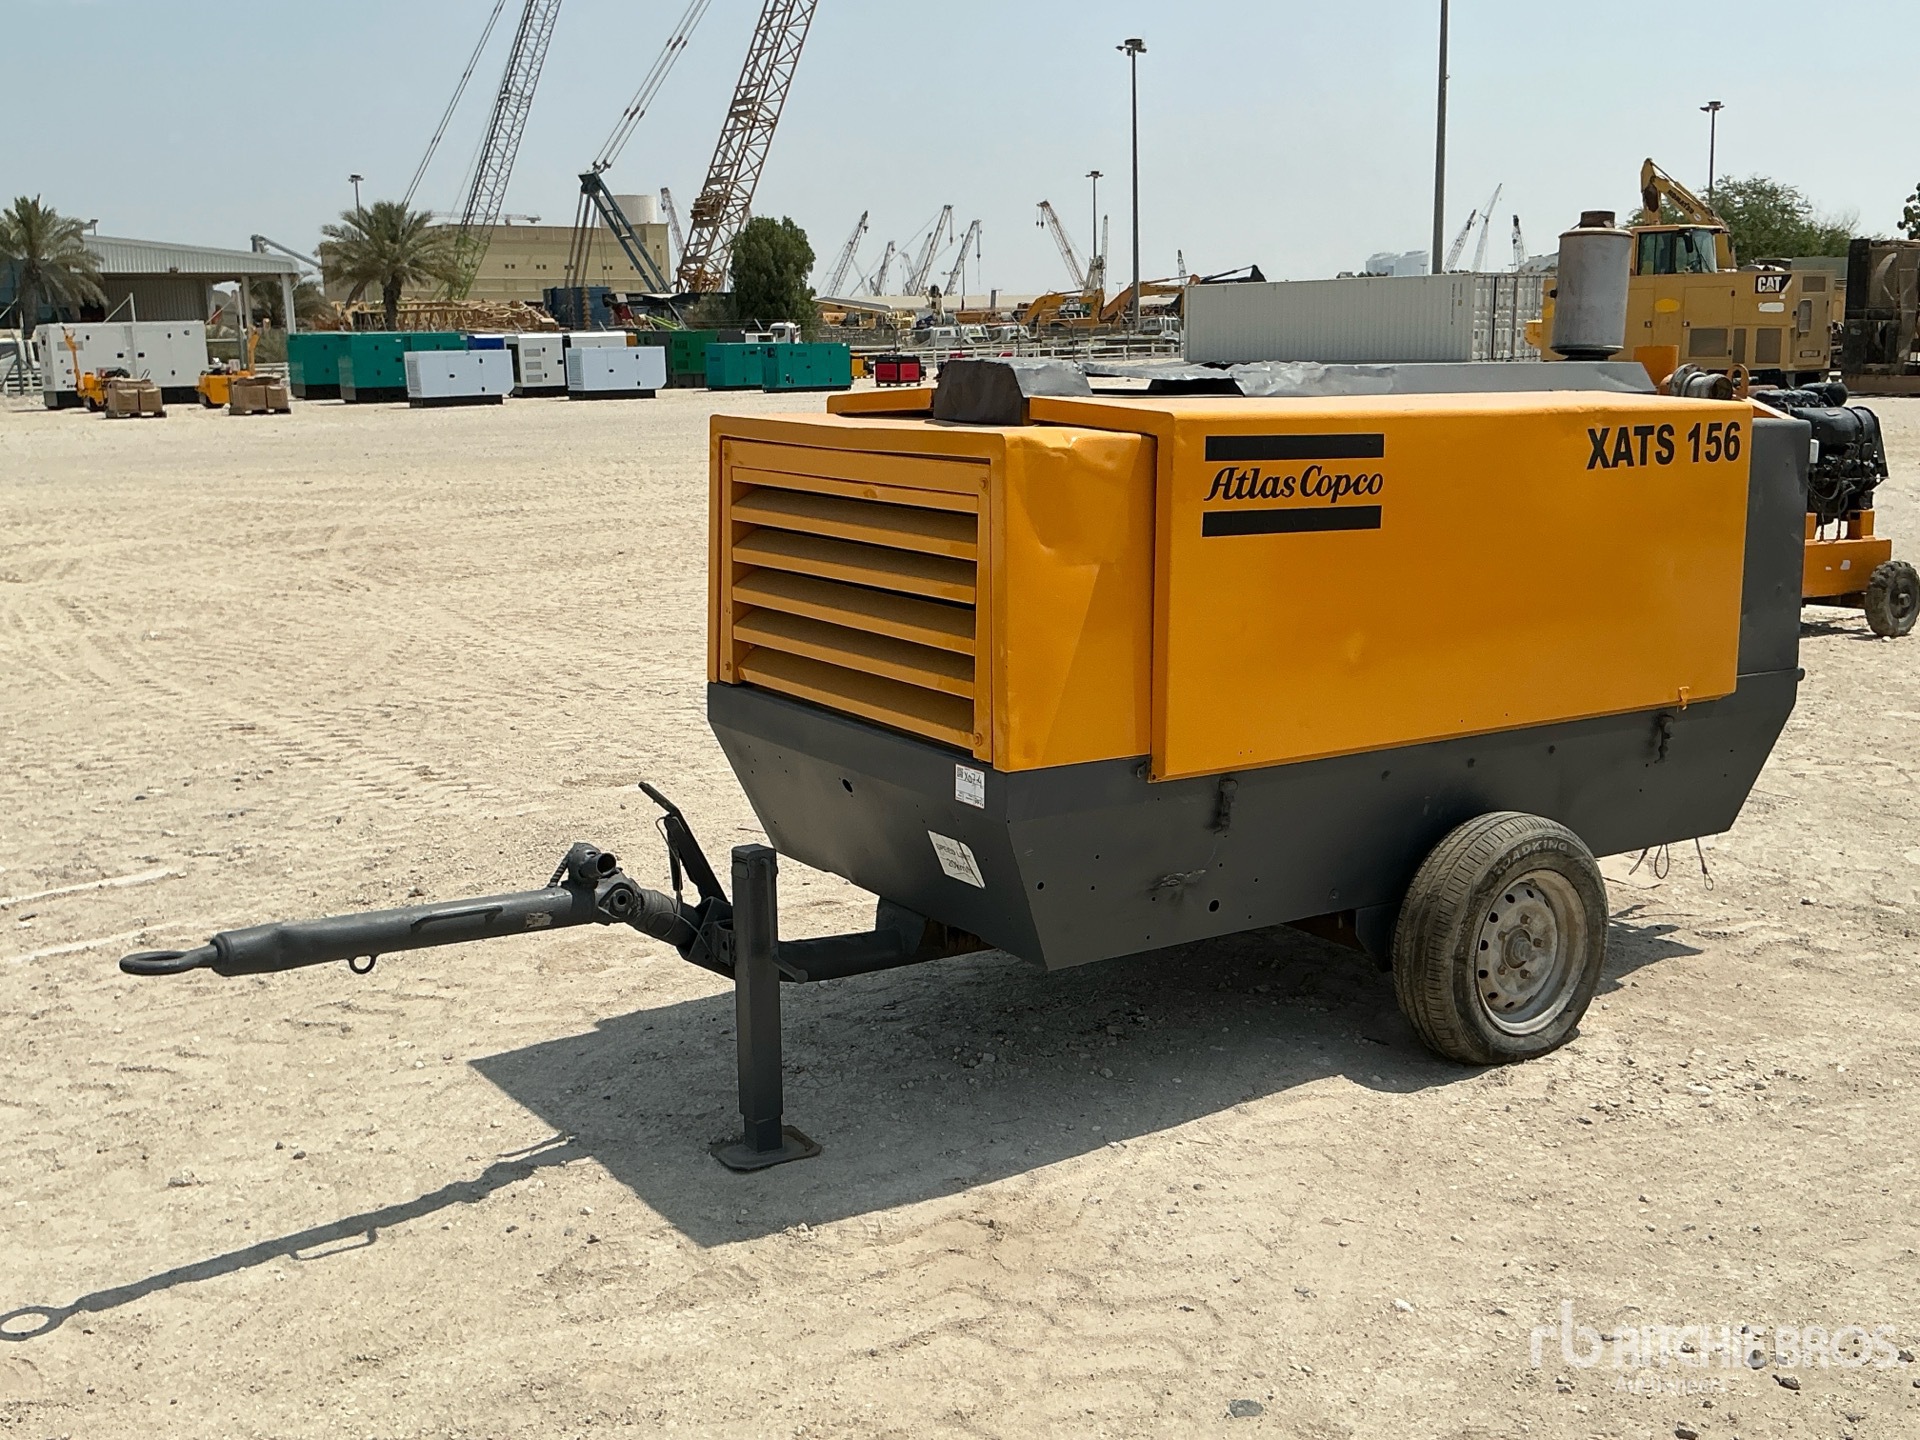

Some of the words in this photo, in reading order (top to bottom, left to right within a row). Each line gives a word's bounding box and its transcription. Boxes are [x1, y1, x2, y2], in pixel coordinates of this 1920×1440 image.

[1667, 189, 1695, 214] KOMATSU
[1757, 276, 1782, 292] CAT
[1586, 424, 1675, 470] XATS
[1687, 421, 1741, 463] 156
[1204, 467, 1296, 501] Atlas
[1300, 465, 1384, 503] Copco
[1493, 839, 1568, 875] ROADKING
